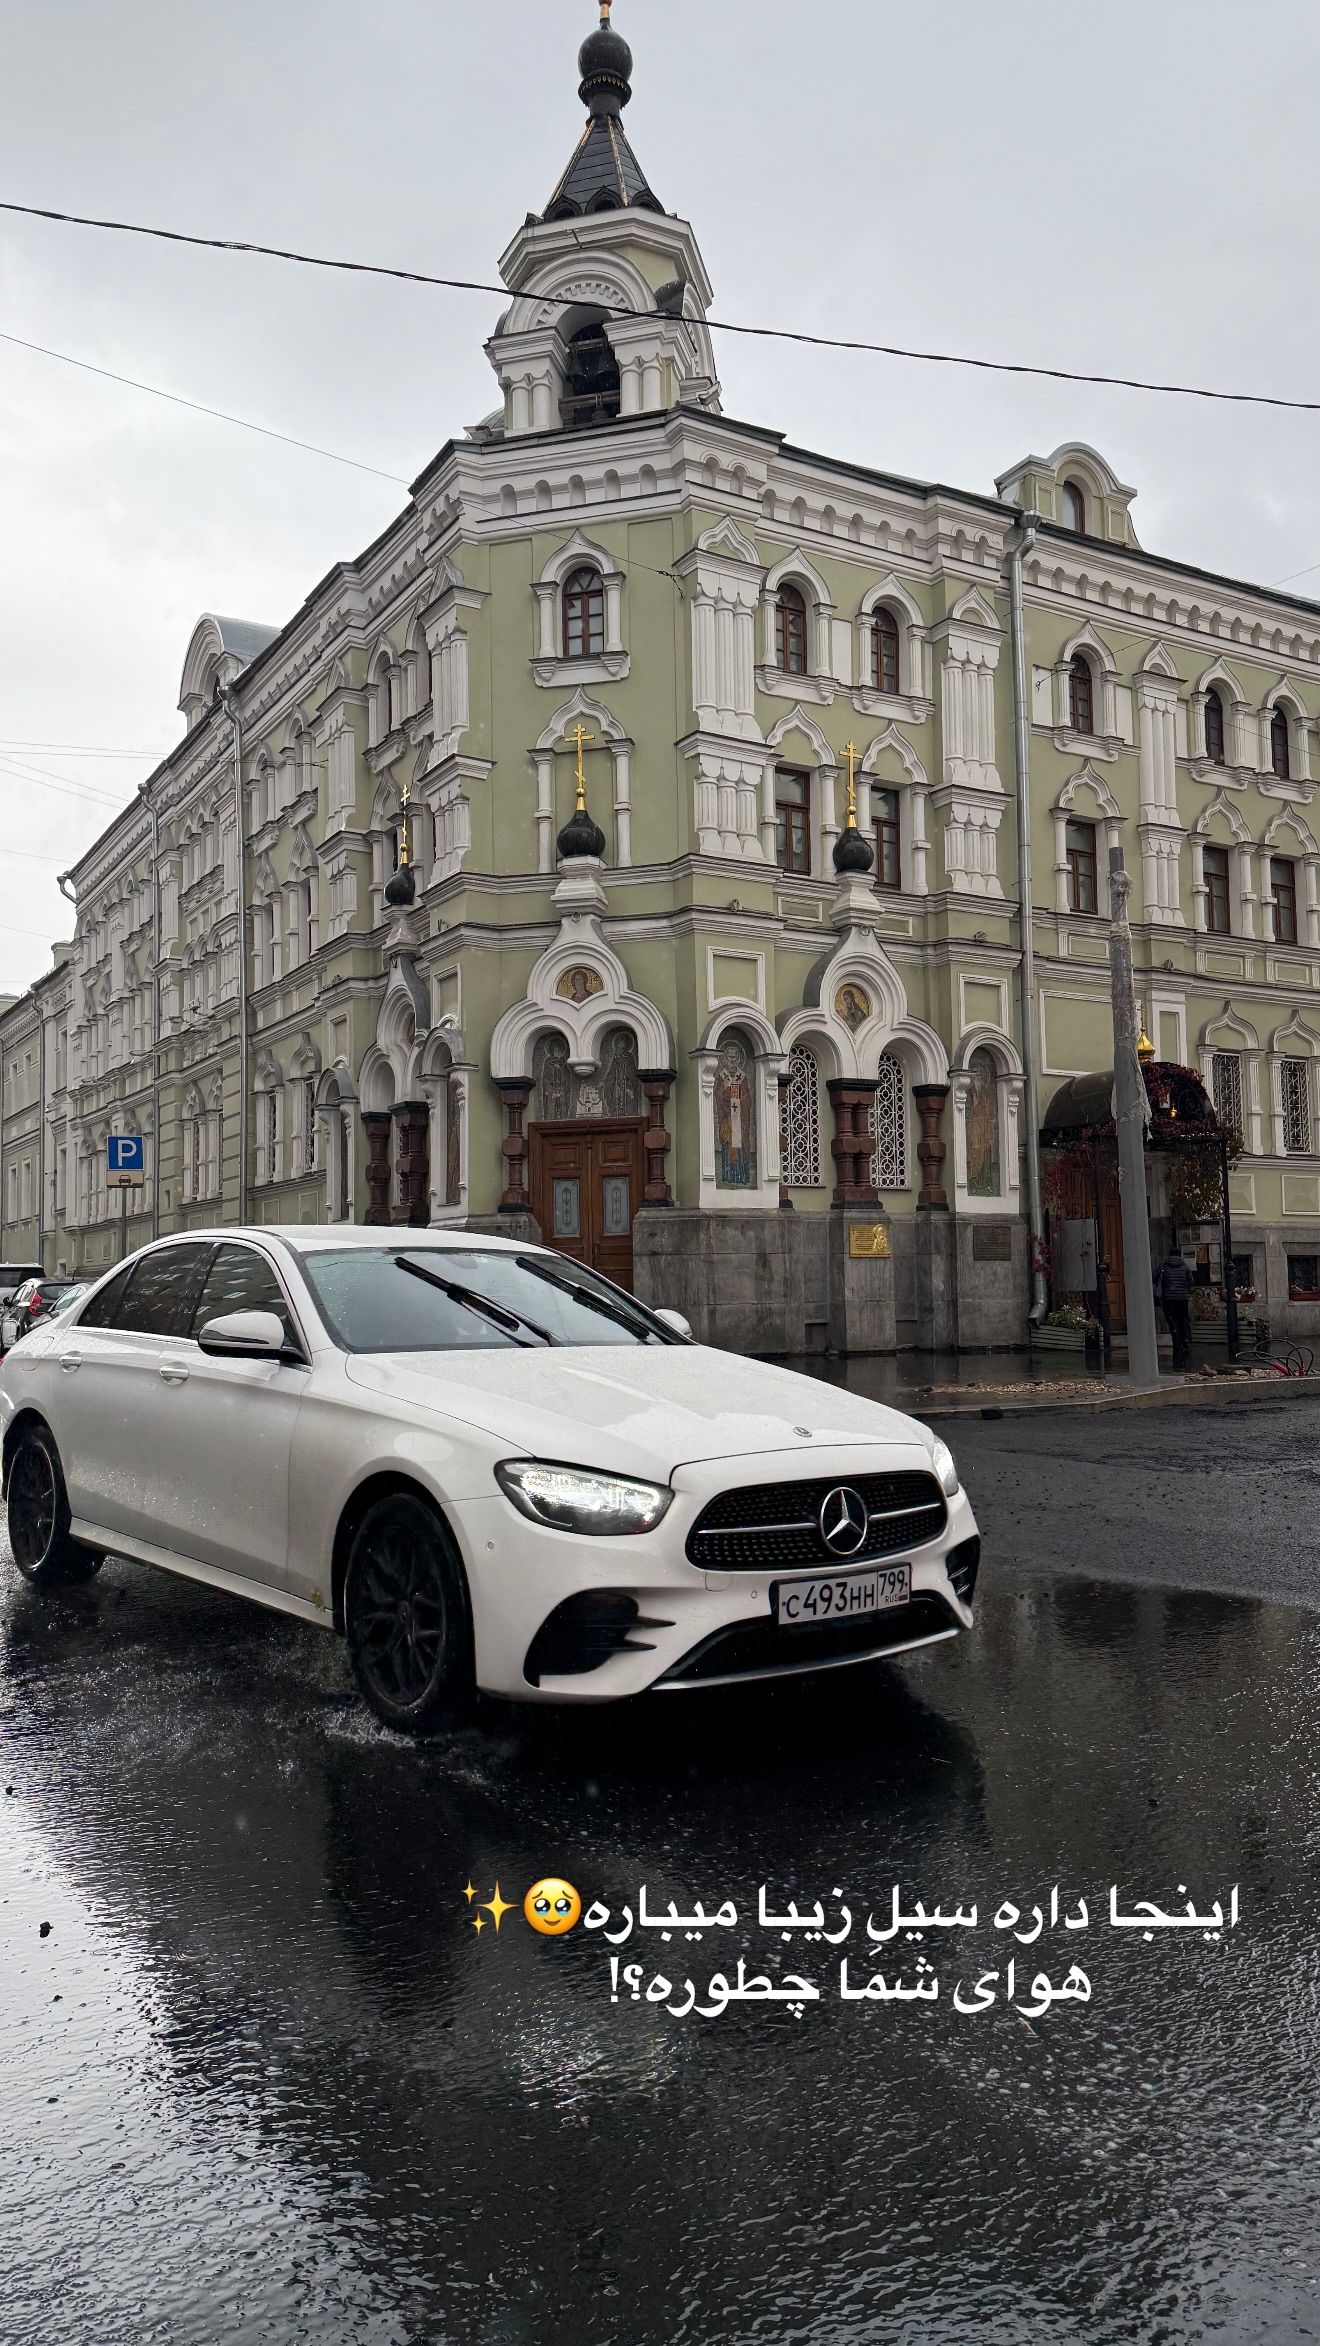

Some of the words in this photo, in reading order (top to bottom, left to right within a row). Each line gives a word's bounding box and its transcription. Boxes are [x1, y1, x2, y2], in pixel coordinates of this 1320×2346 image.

[117, 1139, 137, 1167] P
[878, 1569, 906, 1597] 799
[885, 1593, 899, 1604] RUS
